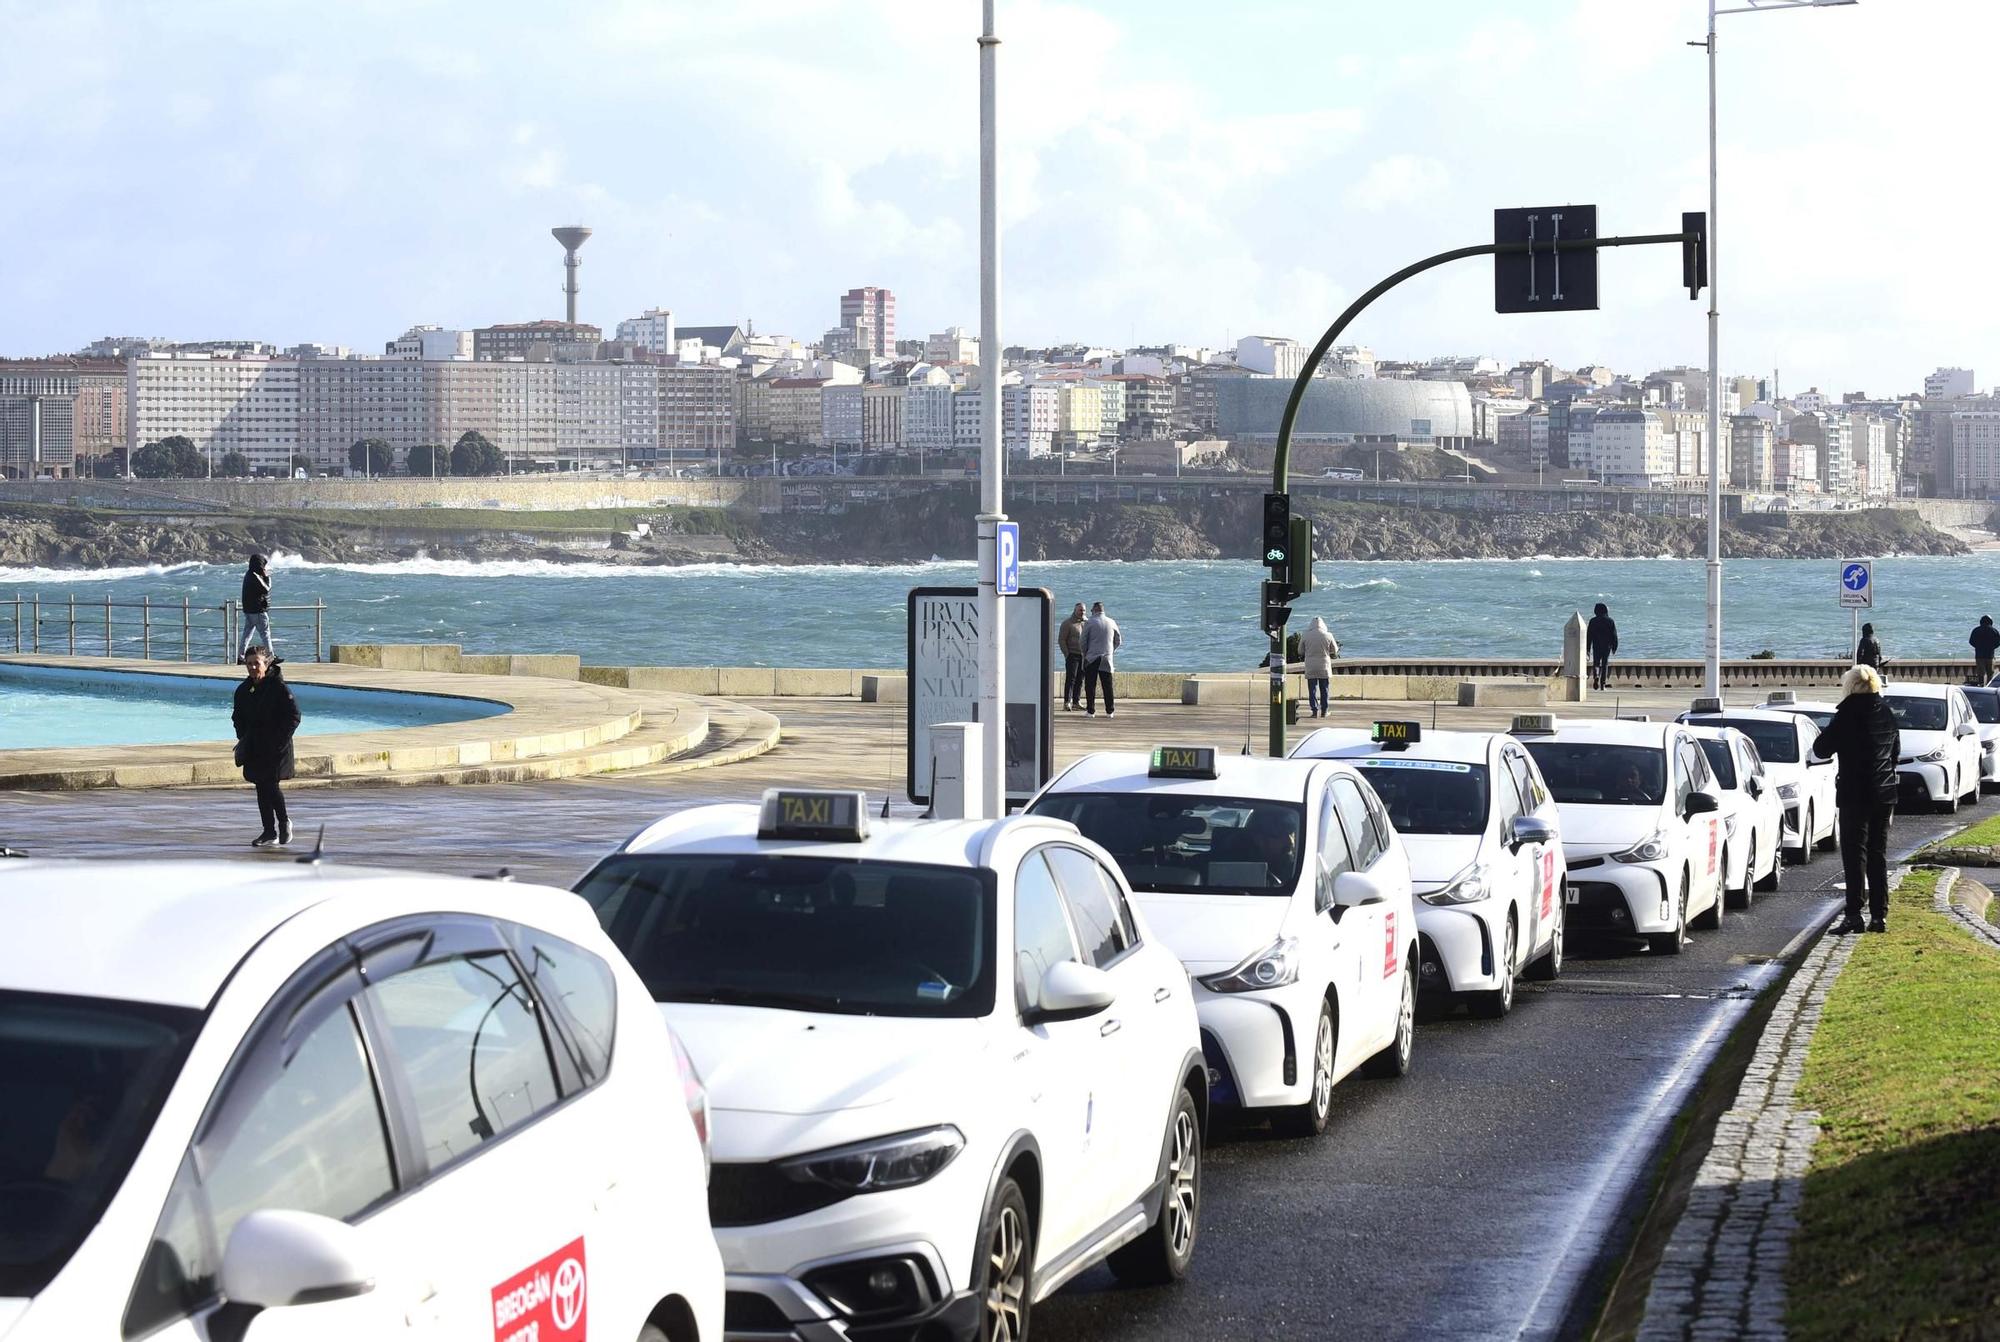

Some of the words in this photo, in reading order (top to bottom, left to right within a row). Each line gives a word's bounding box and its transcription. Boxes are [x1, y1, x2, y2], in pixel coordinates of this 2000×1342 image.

[1001, 531, 1015, 592] P
[923, 601, 979, 621] IRVIN
[923, 620, 979, 640] PENN
[922, 678, 973, 697] NIAL
[1381, 723, 1407, 738] TAXI
[1164, 750, 1196, 767] TAXI
[782, 797, 830, 822] TAXI
[495, 1269, 551, 1329] BREOGÁN
